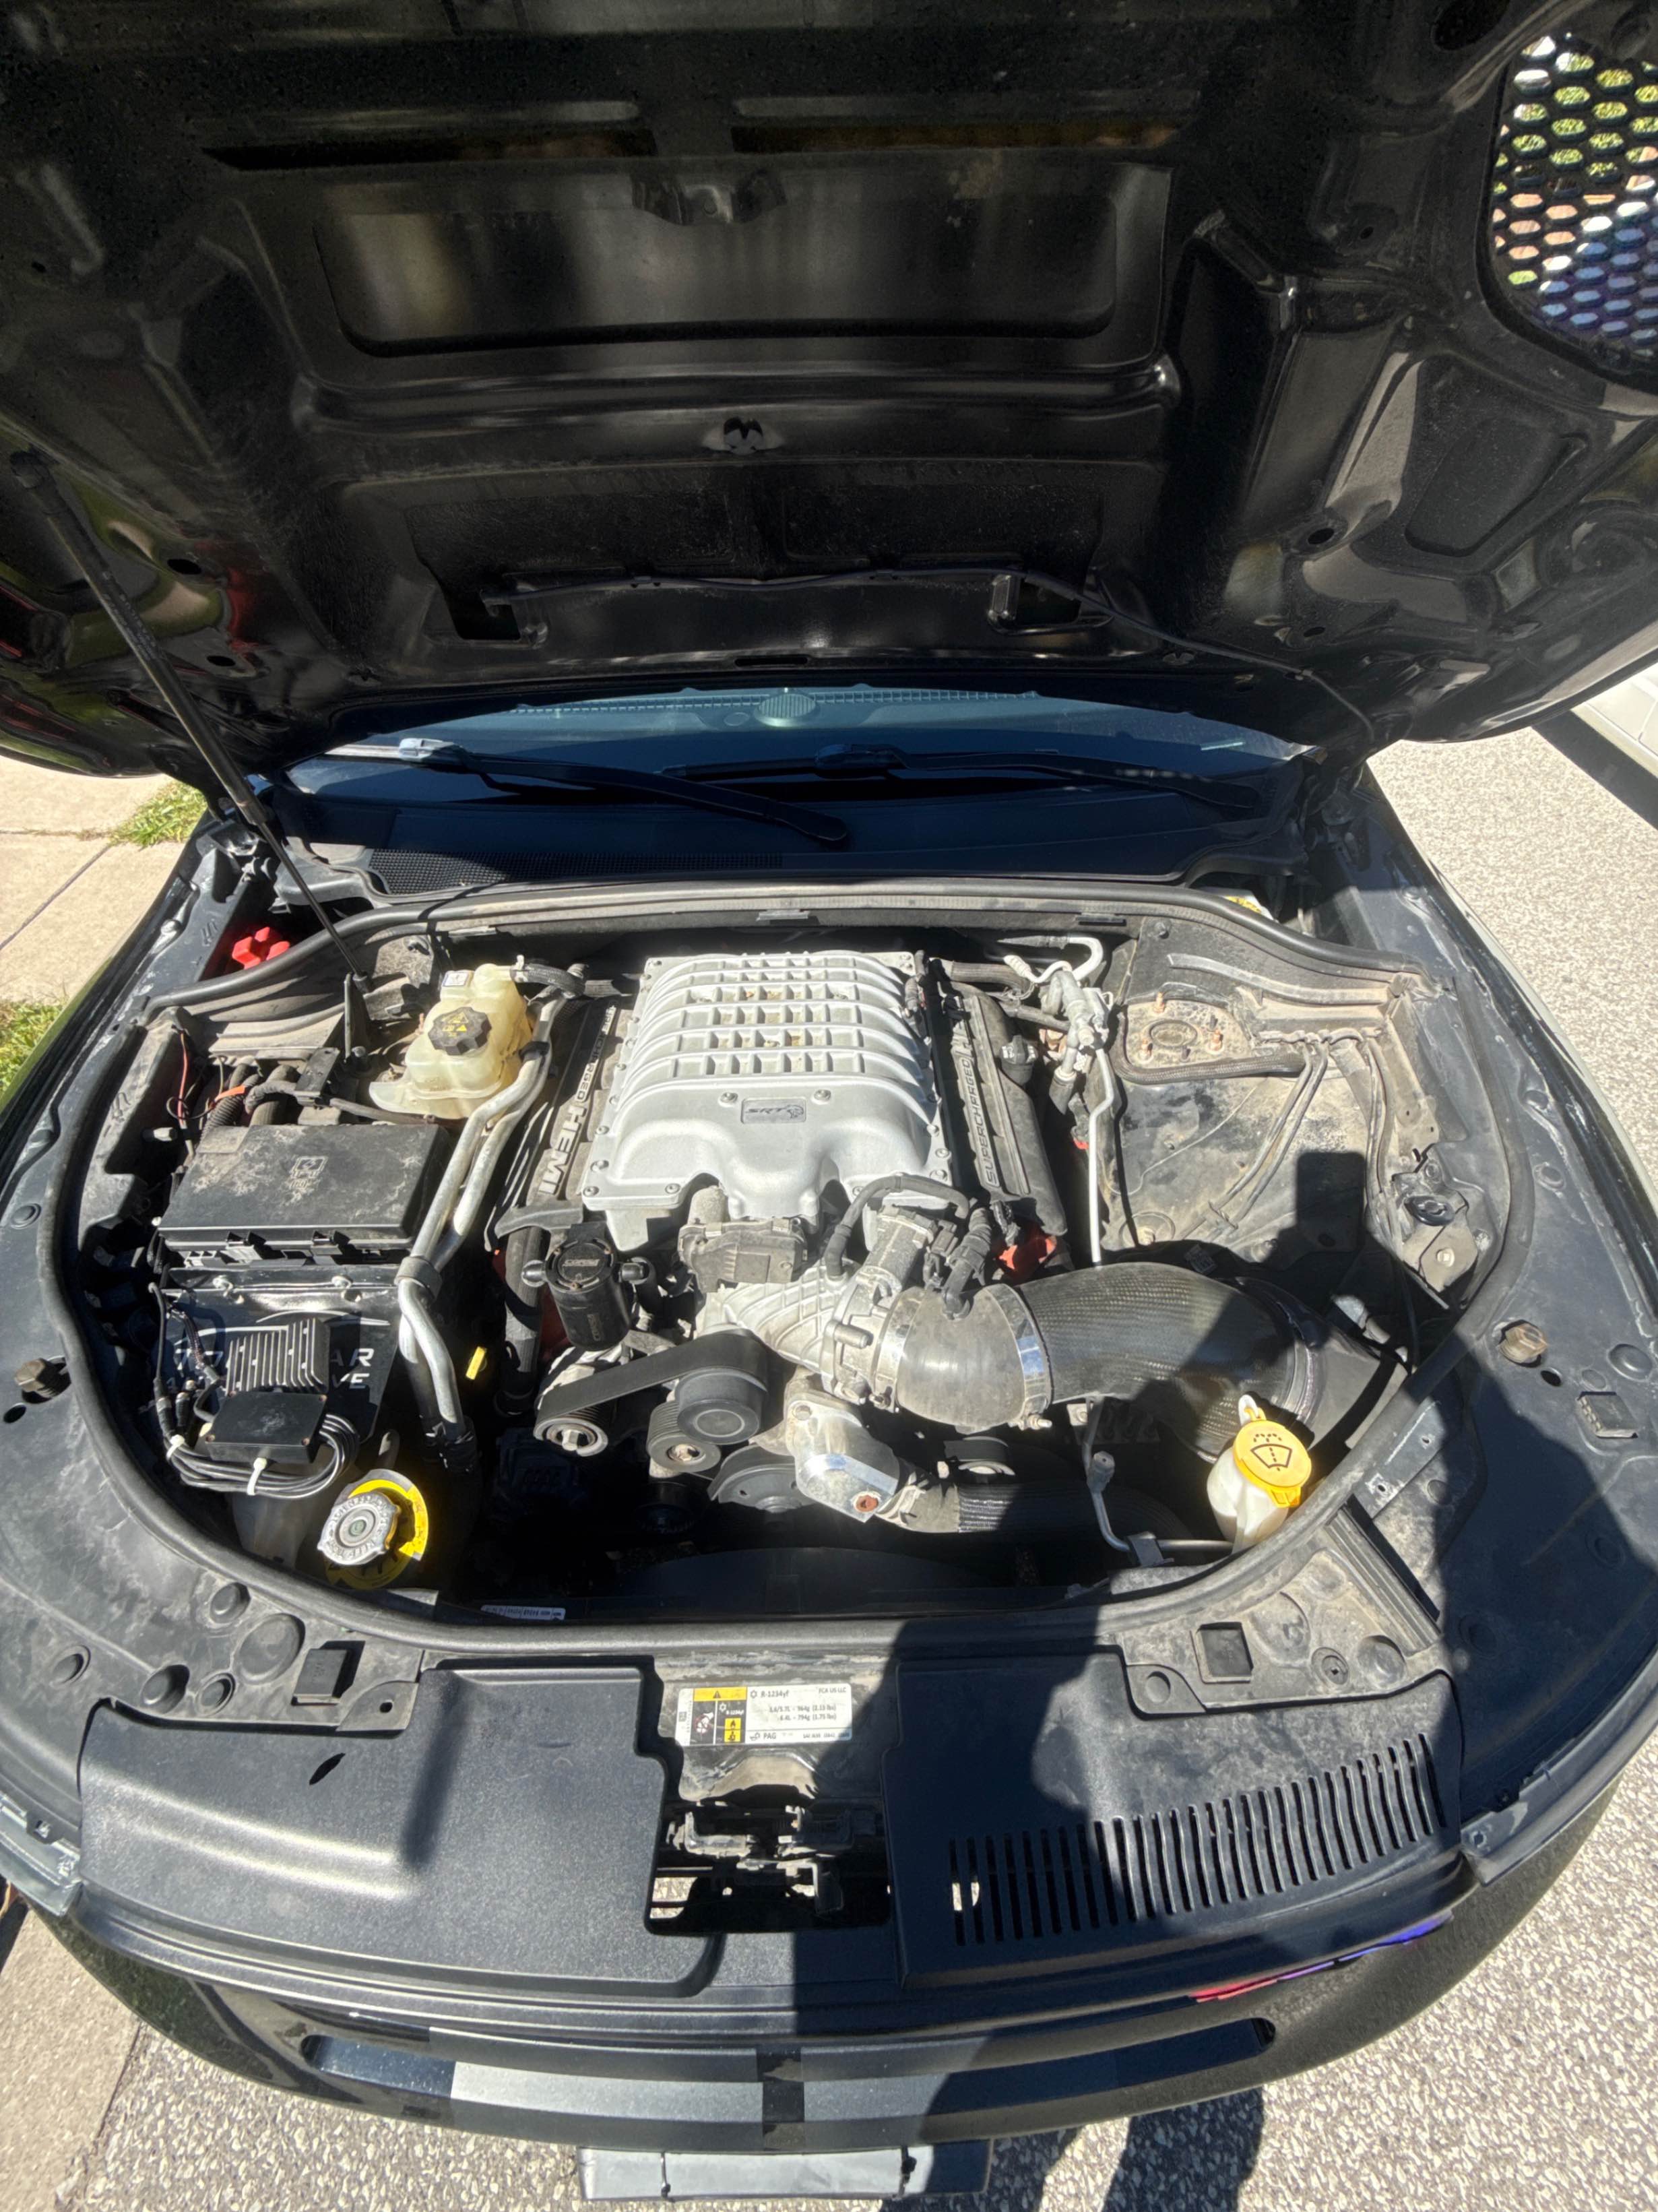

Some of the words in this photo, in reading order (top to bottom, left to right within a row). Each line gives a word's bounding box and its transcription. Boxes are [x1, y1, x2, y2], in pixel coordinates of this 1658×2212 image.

[538, 1106, 587, 1195] HEMI
[961, 1058, 998, 1186] SUPERCHARGED
[761, 1690, 790, 1698] R-1234yf
